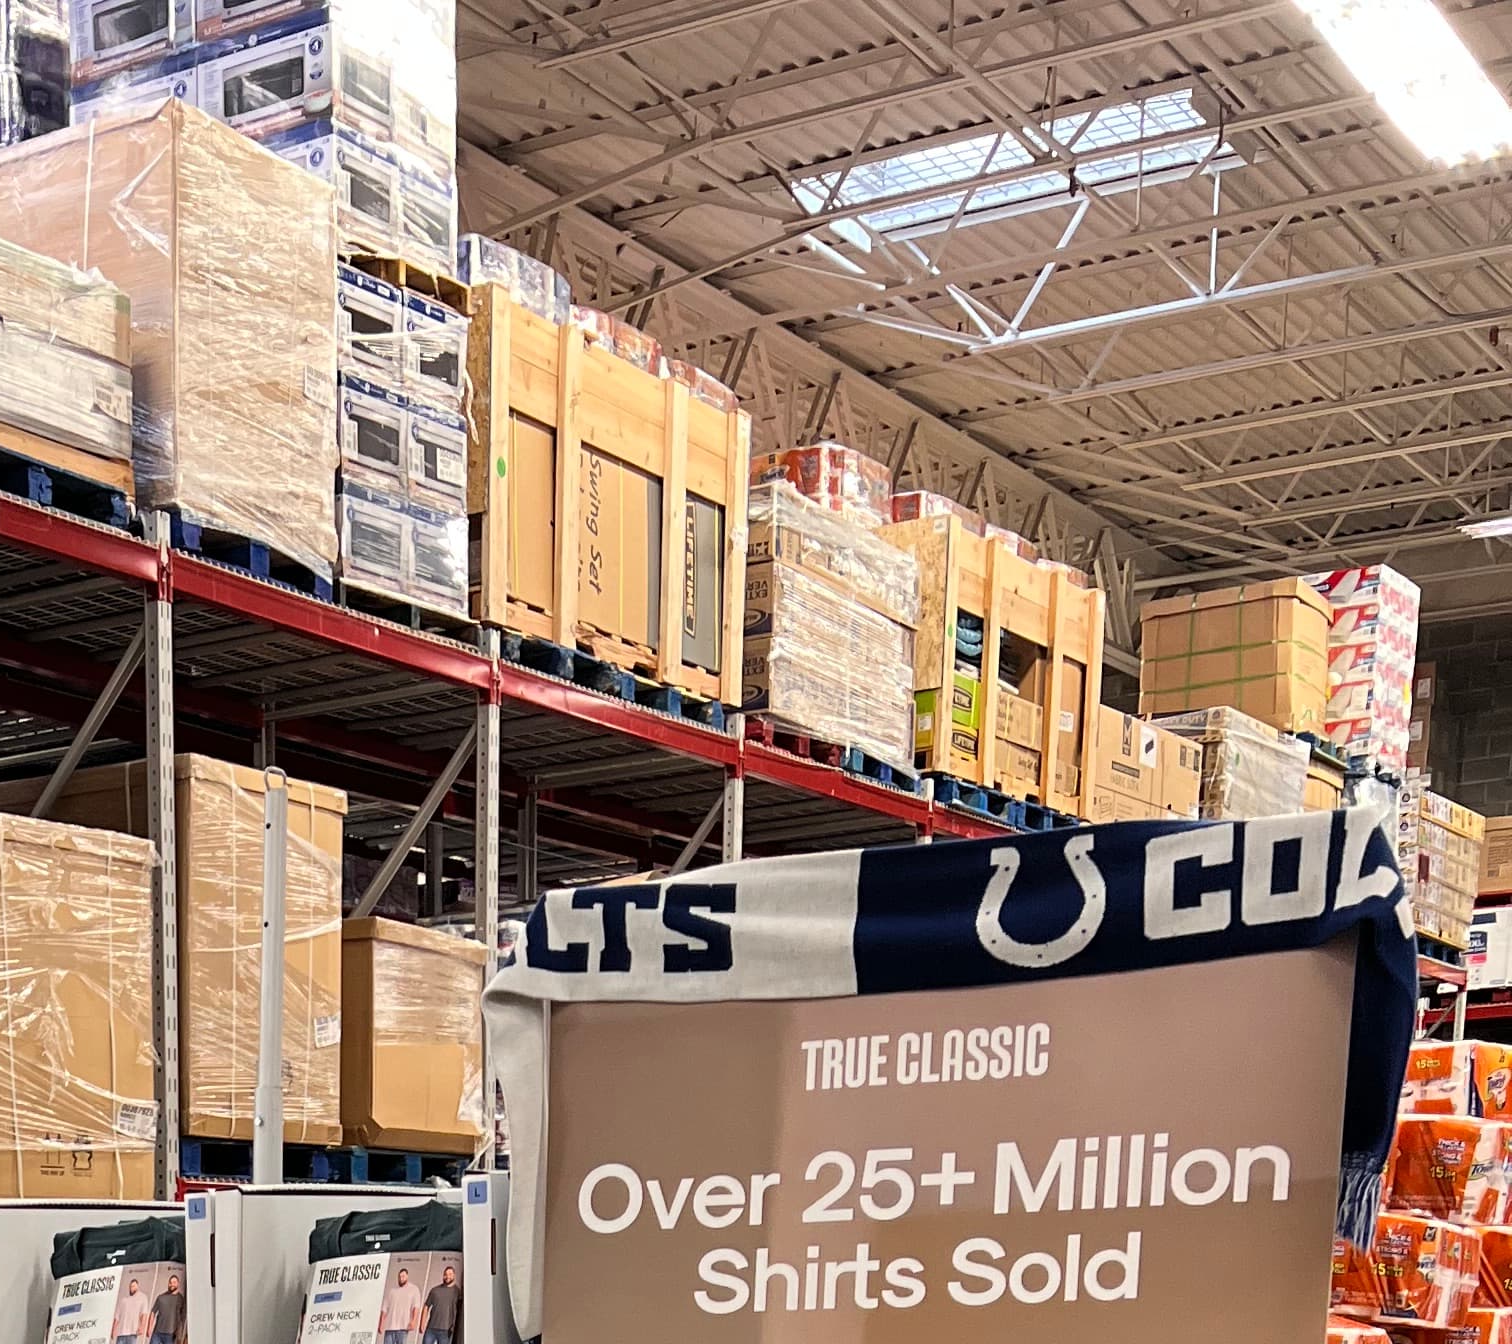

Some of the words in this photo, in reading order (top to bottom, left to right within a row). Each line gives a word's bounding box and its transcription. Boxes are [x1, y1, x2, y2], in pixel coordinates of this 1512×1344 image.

[585, 453, 602, 537] Swing
[589, 546, 603, 595] Set
[801, 1034, 891, 1092] TRUE
[898, 1022, 1050, 1087] CLASSIC
[577, 1162, 781, 1235] Over
[801, 1146, 977, 1225] 25+
[993, 1131, 1290, 1214] Million
[62, 1282, 81, 1299] TRUE
[81, 1275, 115, 1296] CLASSIC
[319, 1268, 339, 1285] TRUE
[341, 1263, 381, 1282] CLASSIC
[692, 1243, 926, 1315] Shirts
[946, 1230, 1143, 1307] Sold
[310, 1313, 335, 1323] CREW
[337, 1310, 361, 1320] NECK
